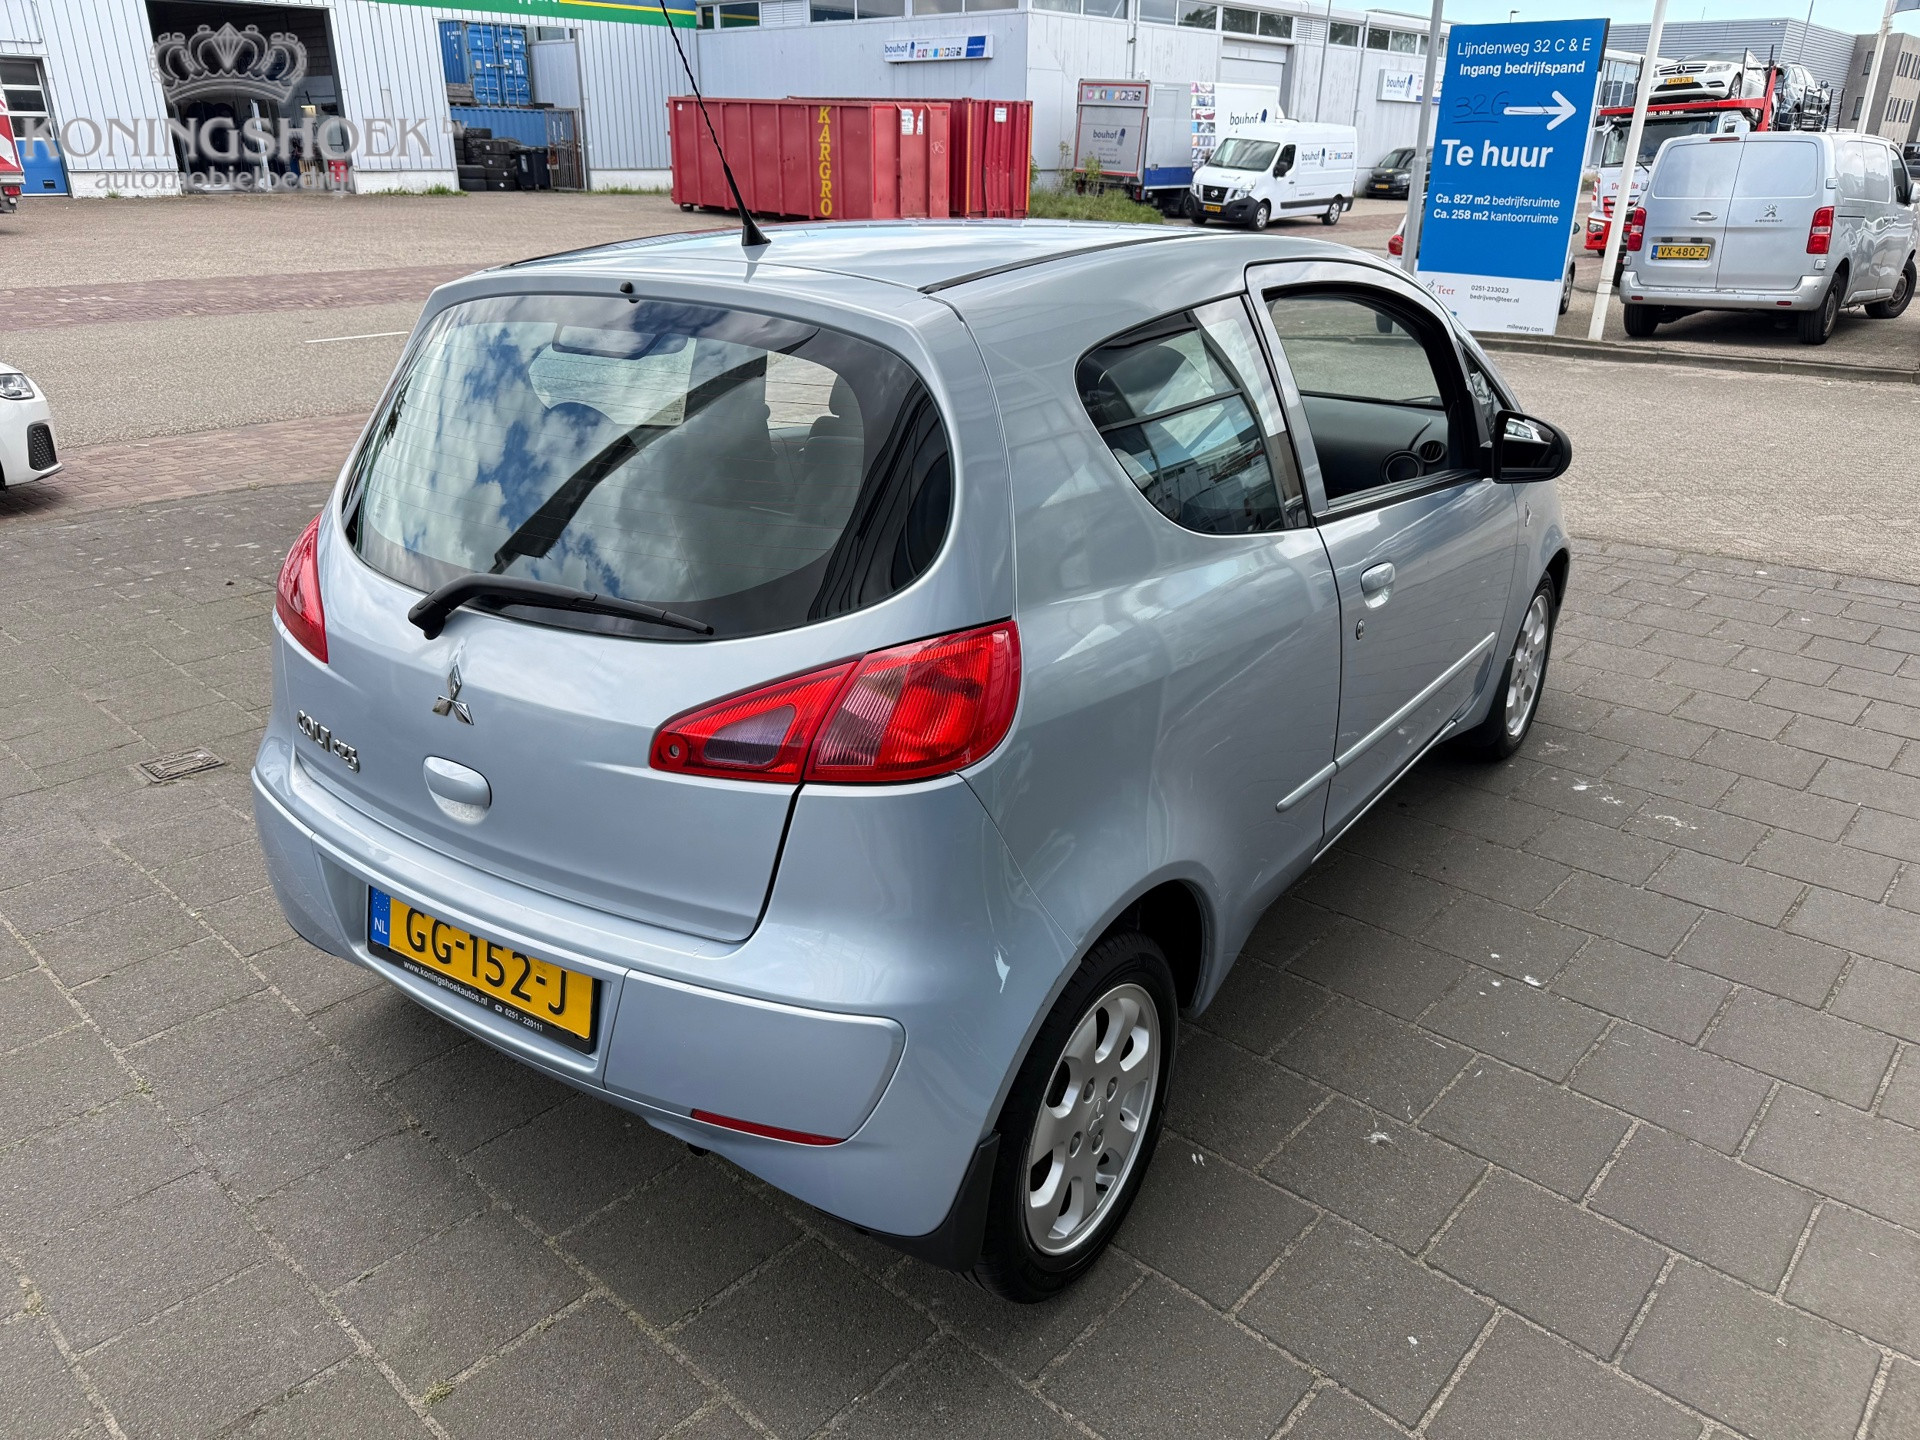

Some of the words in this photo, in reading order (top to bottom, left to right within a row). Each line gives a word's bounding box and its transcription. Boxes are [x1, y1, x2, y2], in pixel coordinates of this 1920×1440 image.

[885, 42, 908, 53] bouhof
[1457, 42, 1530, 58] Lijndenweg
[1533, 40, 1551, 53] 32
[1554, 38, 1566, 52] C
[1568, 38, 1578, 52] &
[1582, 37, 1592, 51] E
[1459, 63, 1502, 77] Ingang
[1504, 60, 1586, 77] bedrijfspand
[1386, 75, 1407, 88] bouhof
[1092, 129, 1118, 139] bouhof
[818, 106, 832, 216] KARGRO
[1441, 139, 1474, 167] Te
[1481, 139, 1554, 168] huur
[1435, 193, 1451, 204] Ca.
[1453, 194, 1473, 204] 827
[1474, 195, 1490, 205] m2
[1492, 196, 1560, 208] bedrijfsruimte
[1433, 208, 1449, 219] Ca.
[1451, 209, 1471, 220] 258
[1473, 211, 1489, 221] m2
[1490, 211, 1559, 224] kantoorruimte
[1660, 247, 1705, 257] VX-480-Z
[1437, 285, 1455, 295] Teer
[1471, 284, 1509, 294] 0251-233023
[1469, 294, 1520, 303] bedrijven@teer.nl
[1507, 323, 1544, 333] mileway.com
[297, 709, 331, 753] COLT
[374, 917, 388, 935] NL
[406, 907, 568, 1016] GG-152-J
[403, 960, 488, 1006] www.koningshoekautos.nl
